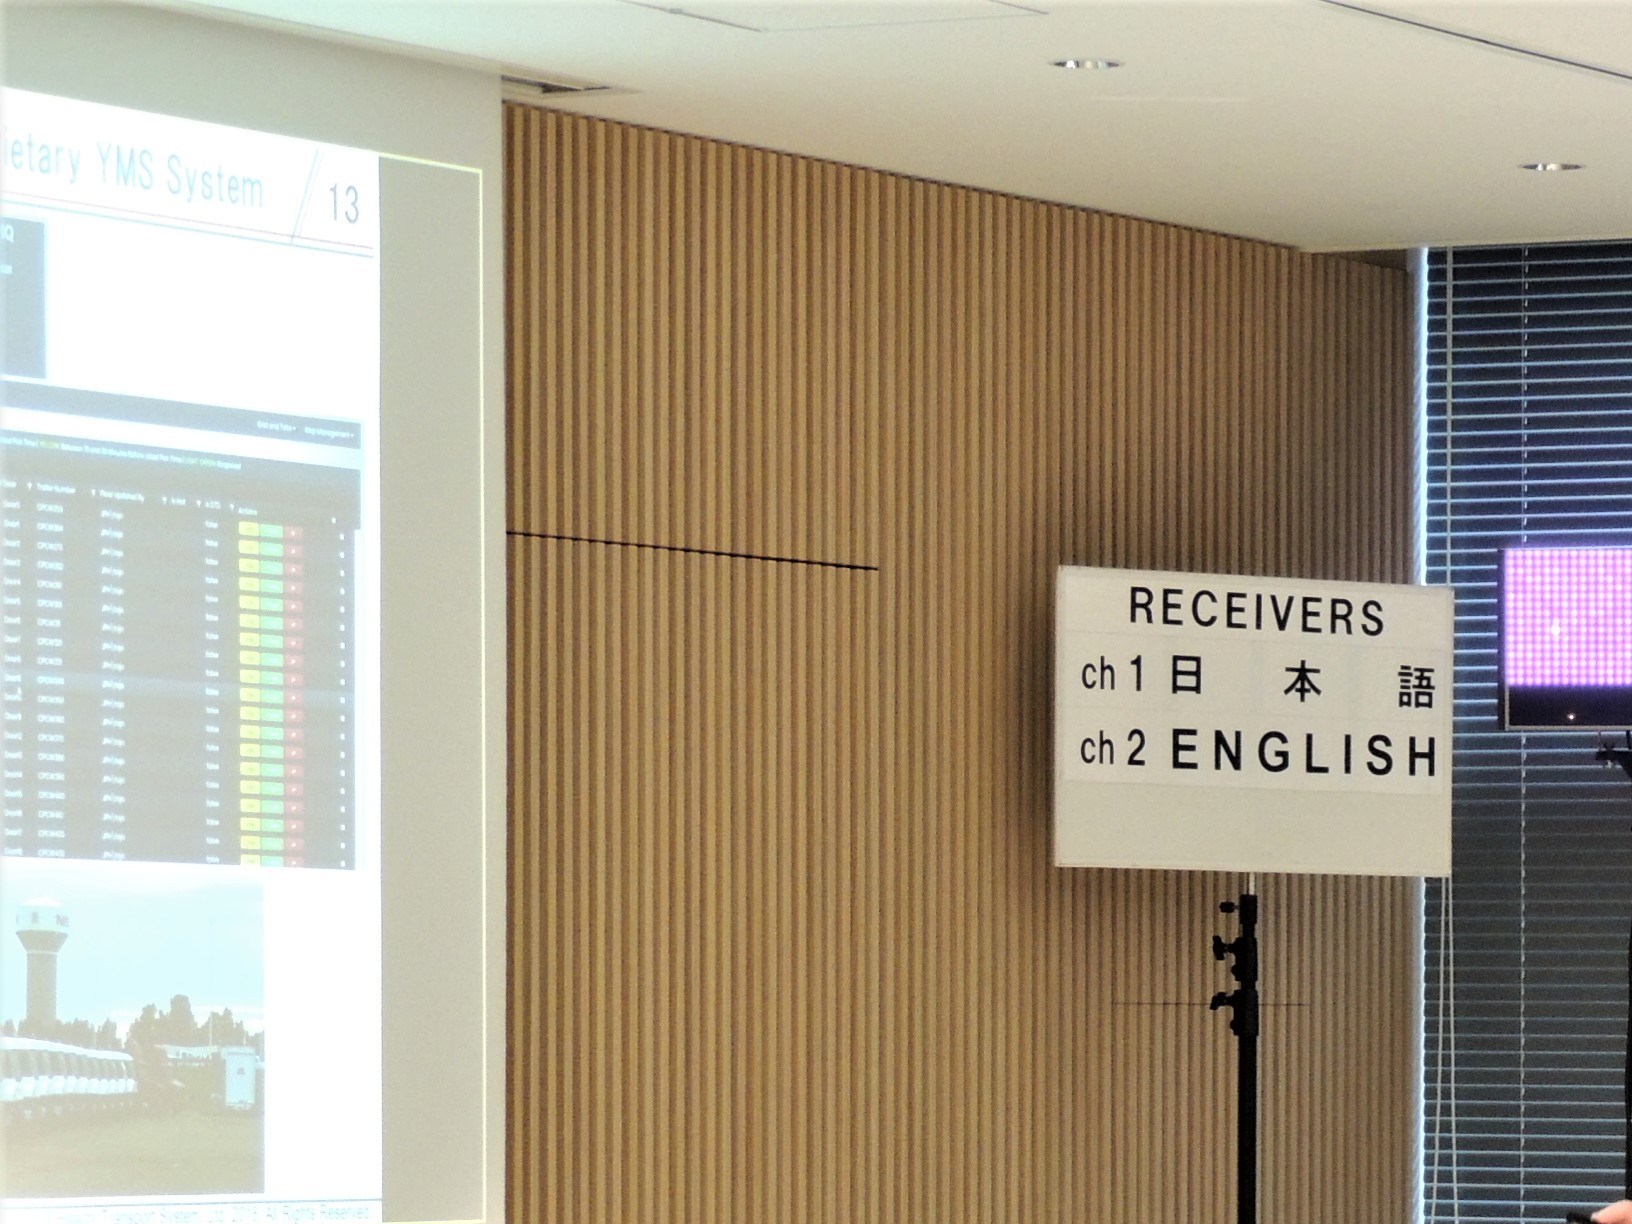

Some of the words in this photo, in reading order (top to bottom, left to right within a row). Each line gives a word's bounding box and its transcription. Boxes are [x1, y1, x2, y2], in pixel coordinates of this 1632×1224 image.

[96, 141, 154, 190] YMS
[166, 153, 265, 209] System
[330, 182, 360, 225] 13
[1130, 586, 1384, 637] RECEIVERS
[1171, 728, 1436, 777] ENGLISH
